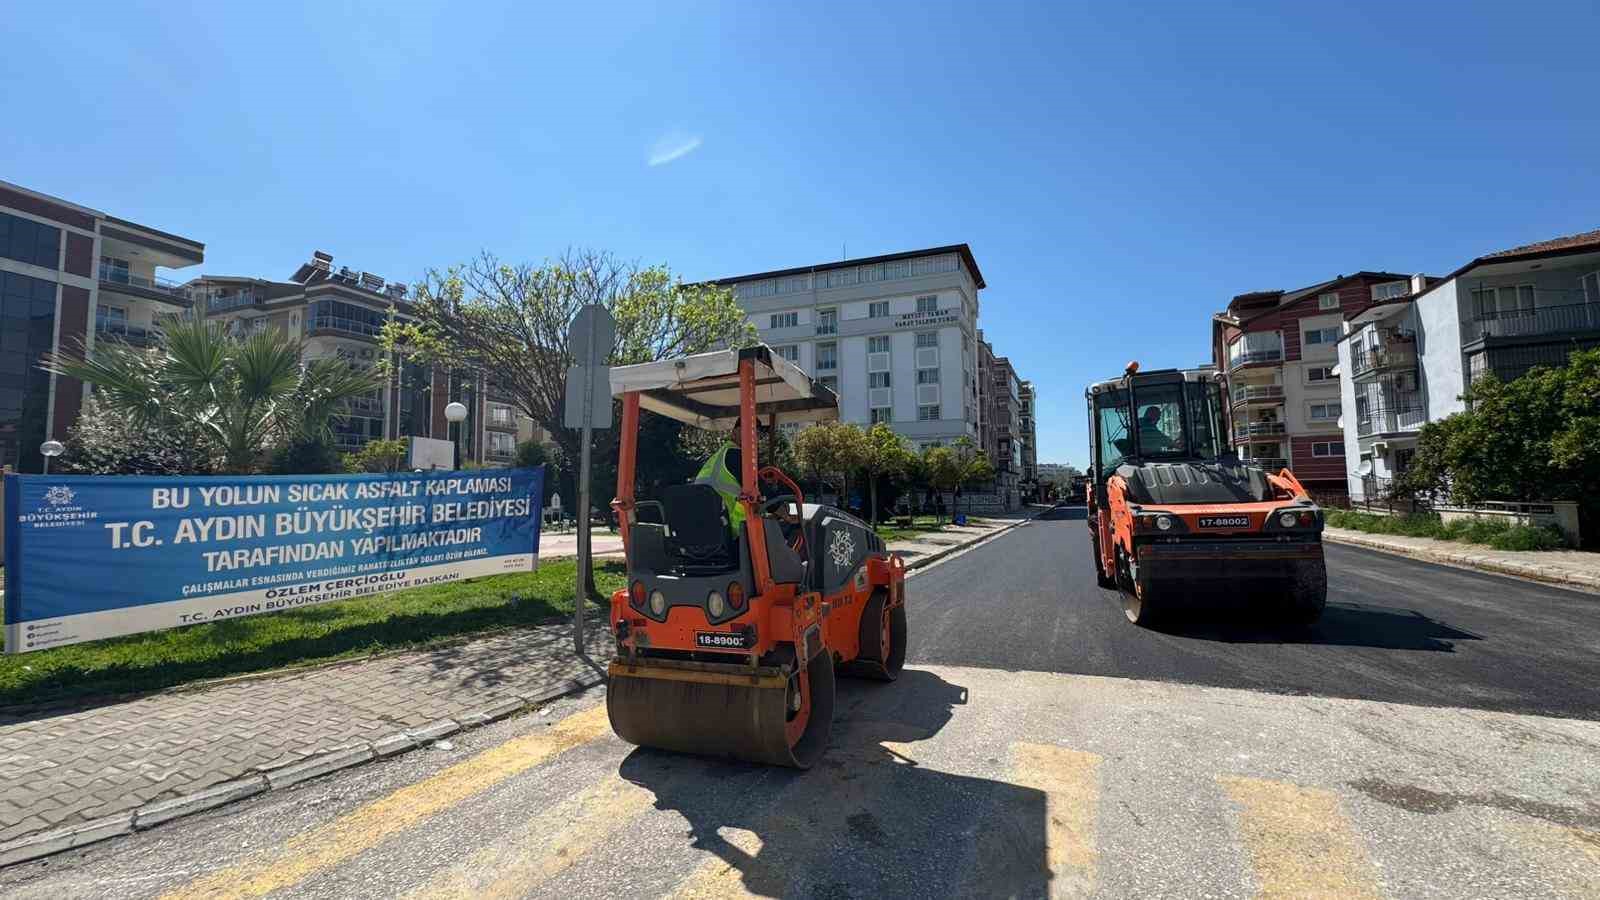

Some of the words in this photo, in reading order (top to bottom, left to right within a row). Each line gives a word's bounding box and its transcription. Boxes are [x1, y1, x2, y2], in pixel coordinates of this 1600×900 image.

[152, 487, 190, 509] BU
[200, 486, 280, 506] YOLUN
[288, 483, 350, 503] SICAK
[355, 481, 421, 499] ASFALT
[426, 477, 512, 496] KAPLAMASI
[104, 521, 163, 549] T.C.
[174, 514, 265, 544] AYDIN
[275, 502, 426, 536] BÜYÜKŞEHİR
[432, 494, 530, 523] BELEDİYESİ
[202, 540, 344, 572] TARAFINDAN
[351, 527, 481, 555] YAPILMAKTADIR
[180, 613, 208, 623] T.C.
[213, 604, 261, 618] AYDIN
[266, 589, 351, 609] BÜYÜKŞEHİR
[355, 580, 412, 595] BELEDİYE
[414, 572, 459, 586] BAŞKANI
[182, 578, 249, 596] ÇALIŞMALAR
[251, 571, 304, 586] ESNASINDA
[265, 583, 321, 598] ÖZLEM
